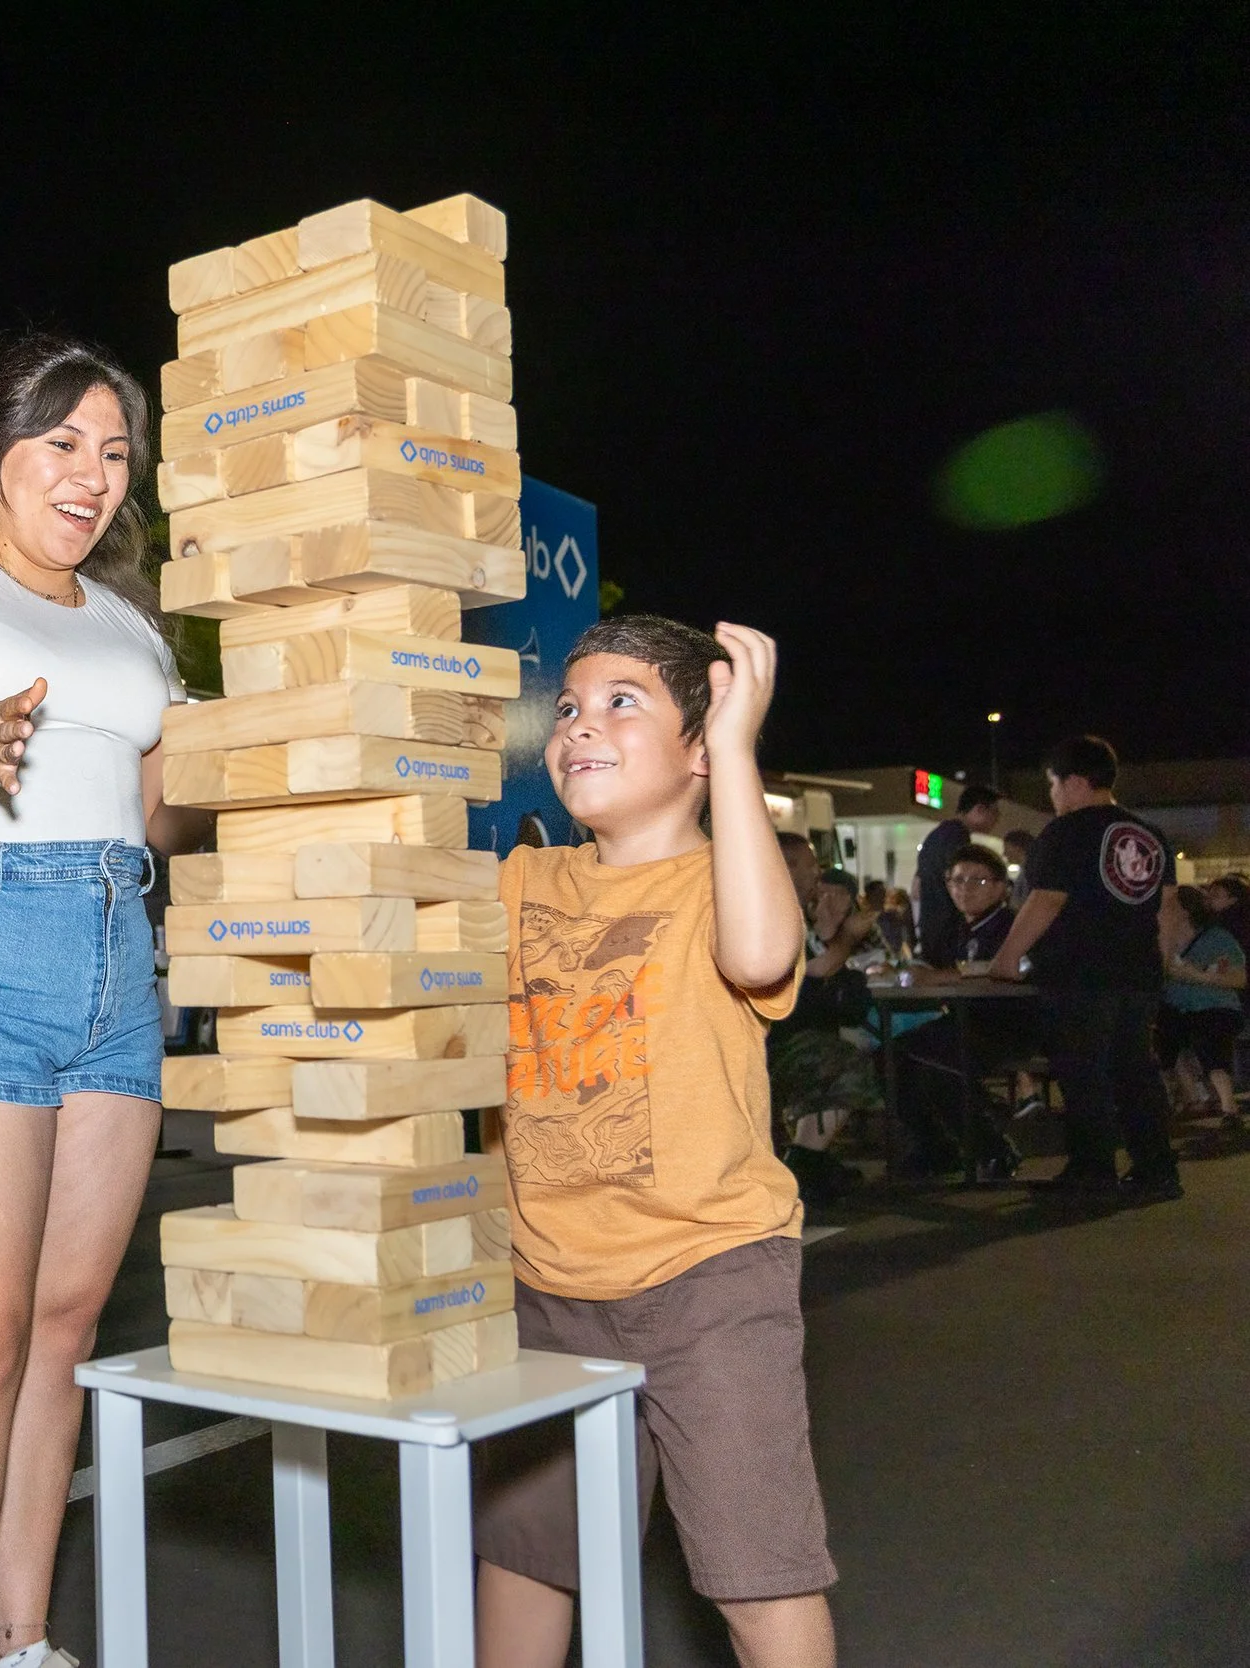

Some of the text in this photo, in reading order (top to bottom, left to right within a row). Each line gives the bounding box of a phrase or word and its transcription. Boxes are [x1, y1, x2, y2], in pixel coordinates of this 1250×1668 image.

[226, 391, 306, 427] sam's club
[419, 447, 485, 475] sam's club
[391, 651, 462, 673] sam's club
[413, 760, 470, 781] sam's club
[230, 920, 310, 940] sam's club
[261, 1020, 340, 1039] sam's club
